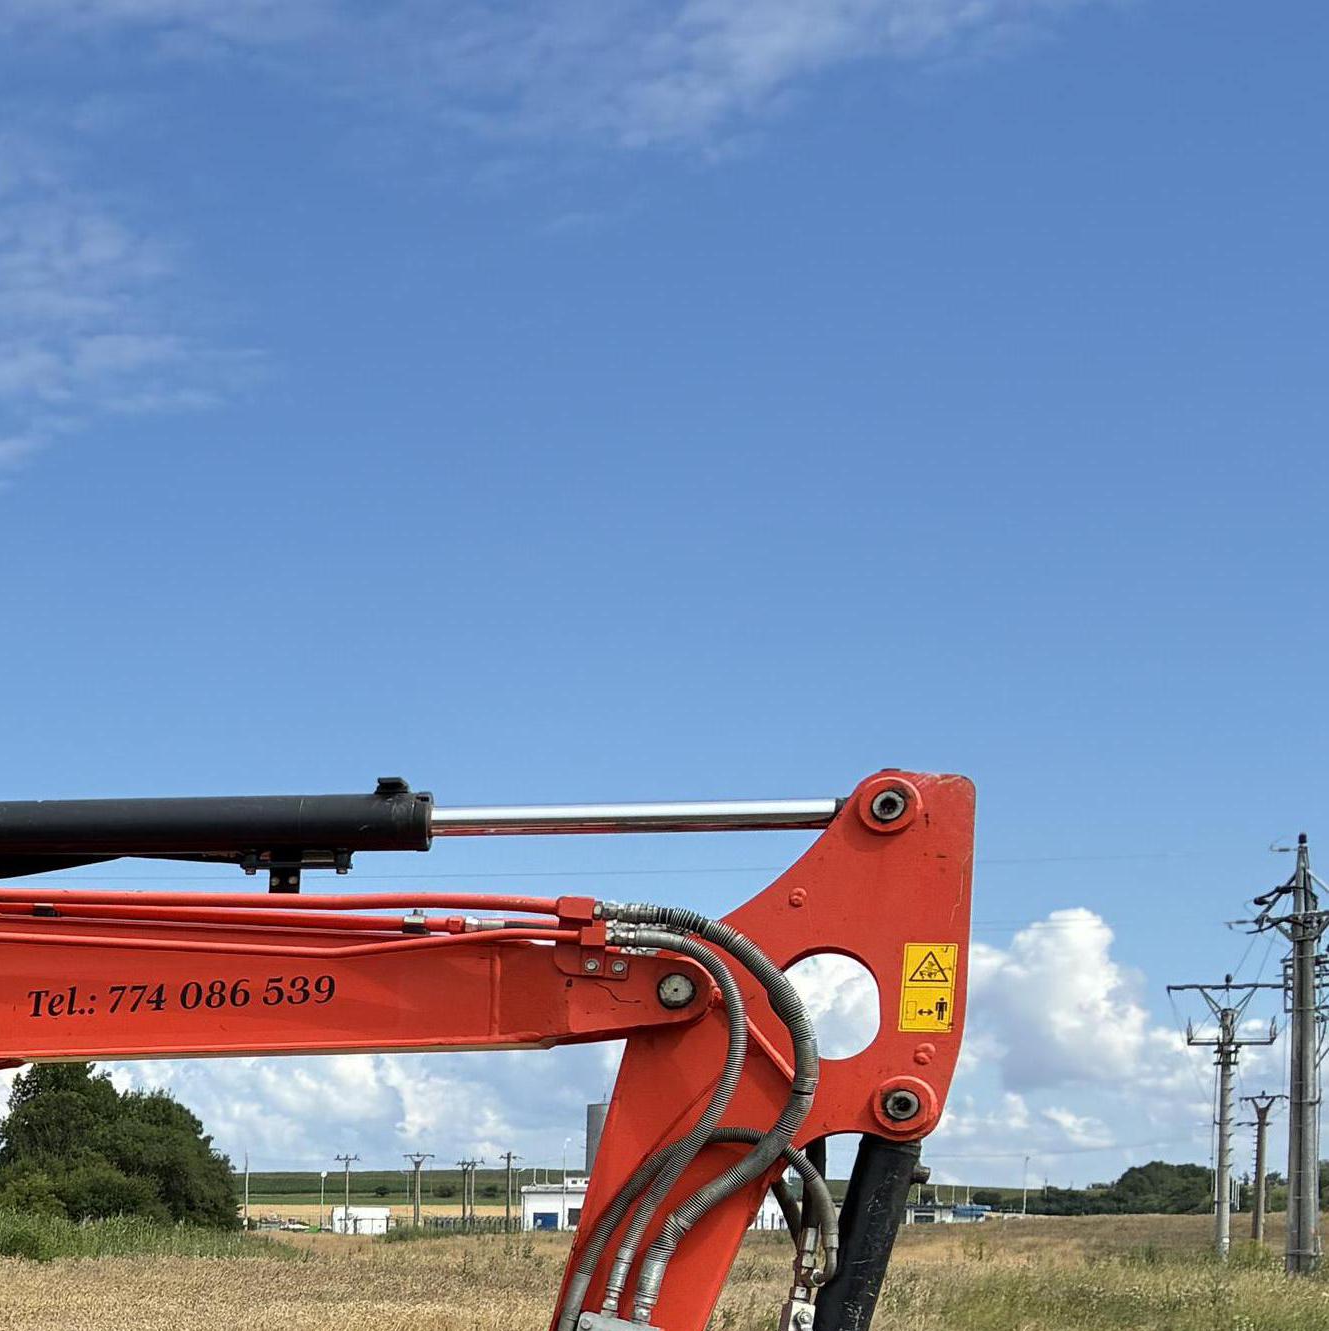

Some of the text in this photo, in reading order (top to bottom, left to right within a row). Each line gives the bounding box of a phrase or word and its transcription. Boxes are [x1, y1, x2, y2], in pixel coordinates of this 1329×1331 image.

[28, 975, 335, 1017] Tel.: 774 086 539
